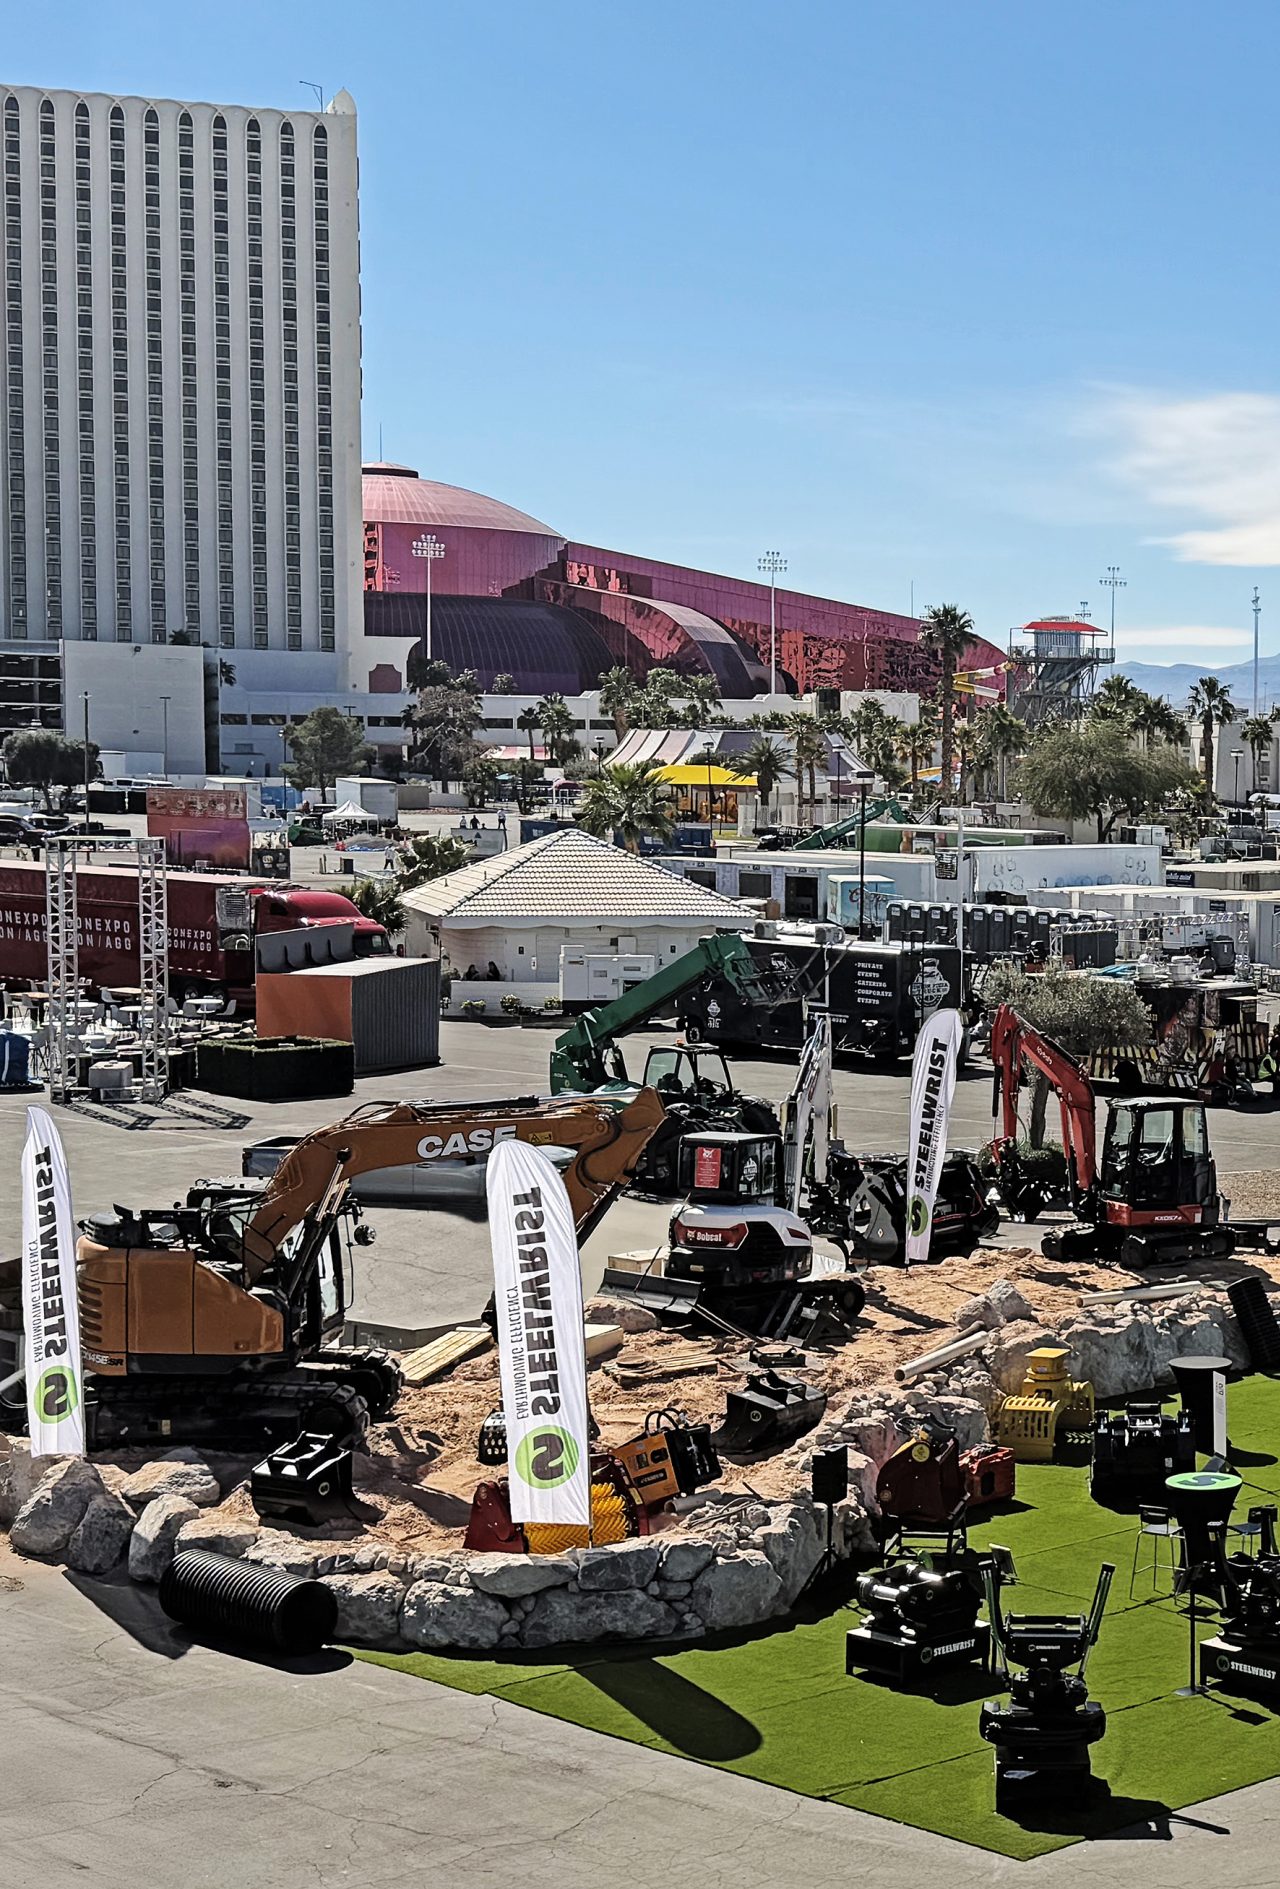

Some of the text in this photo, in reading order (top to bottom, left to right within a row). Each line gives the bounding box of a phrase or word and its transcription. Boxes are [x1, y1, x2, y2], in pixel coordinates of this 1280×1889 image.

[914, 1037, 948, 1190] STEELWRIST
[417, 1125, 517, 1159] CASE
[696, 1231, 722, 1242] Bobcat
[933, 1638, 976, 1657] STEELWRIST
[1230, 1661, 1277, 1680] STEELWRIST
